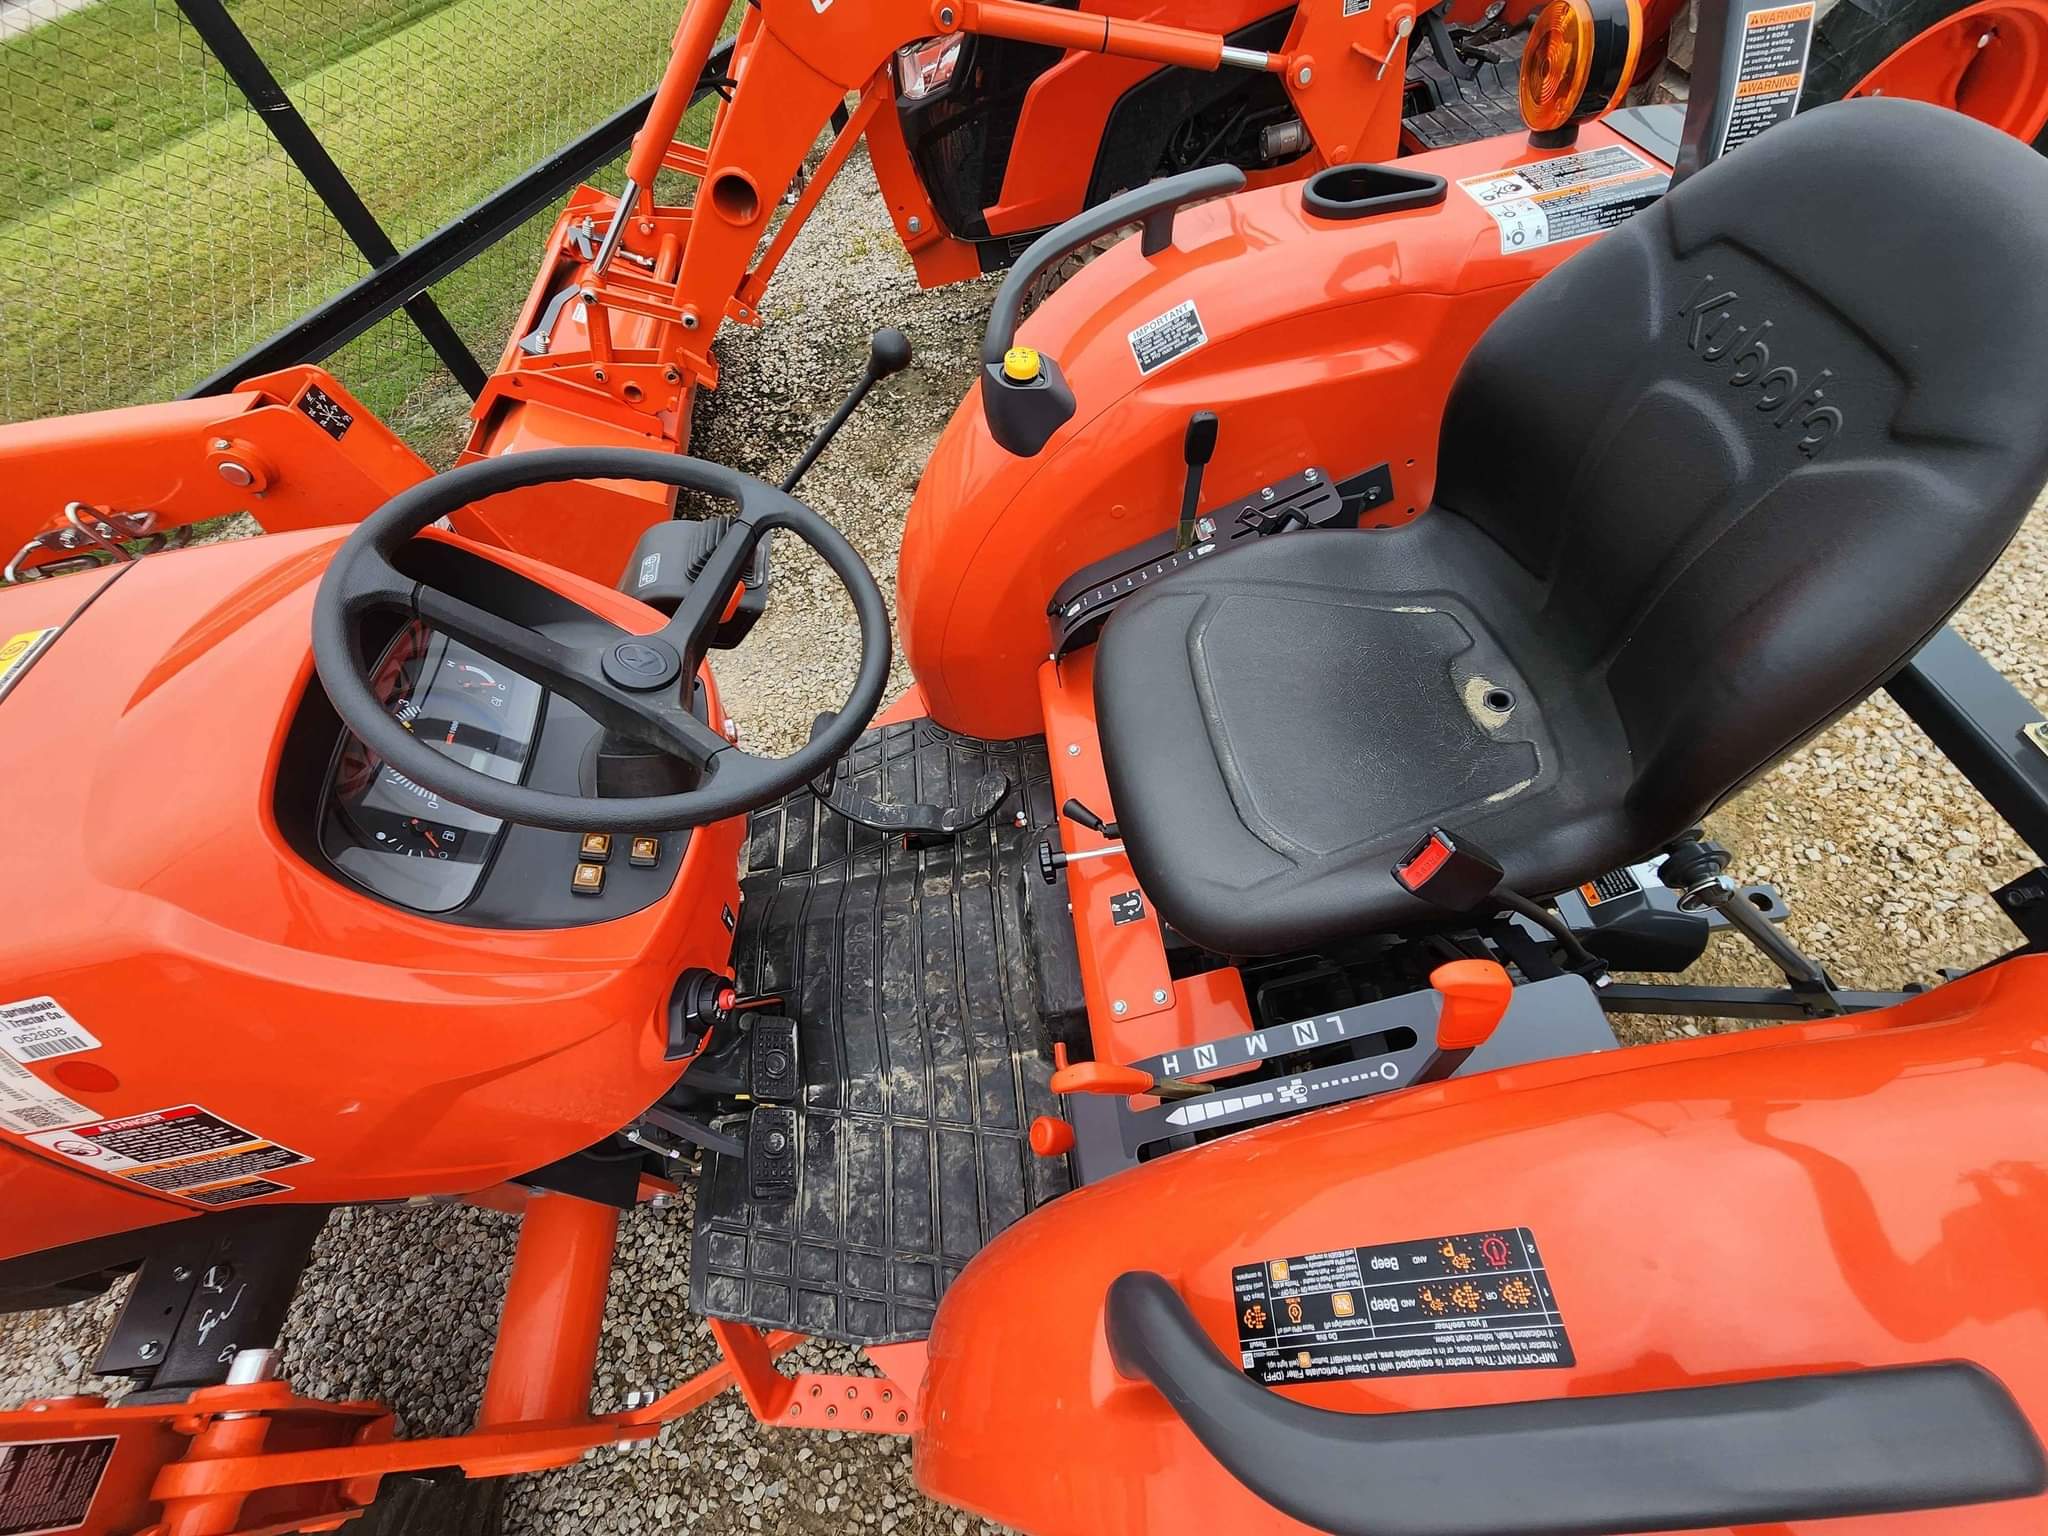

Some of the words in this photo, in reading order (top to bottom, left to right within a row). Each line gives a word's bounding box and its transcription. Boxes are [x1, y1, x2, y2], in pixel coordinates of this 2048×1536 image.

[1760, 7, 1812, 23] WARNING
[1748, 76, 1799, 92] WARNING
[1131, 304, 1188, 339] IMPORTANT
[1678, 274, 1843, 459] Kubota
[447, 660, 456, 668] H
[498, 683, 506, 691] C
[398, 698, 410, 707] 3
[427, 801, 439, 809] 0
[8, 1015, 47, 1028] Tractor
[46, 1012, 65, 1020] Co.
[1326, 1016, 1345, 1035] L
[12, 1027, 67, 1044] 062808
[1294, 1023, 1317, 1044] N
[1246, 1033, 1268, 1055] M
[1195, 1046, 1216, 1068] N
[1162, 1055, 1180, 1075] H
[109, 1114, 165, 1131] DANGER
[1526, 1243, 1535, 1253] 2
[1370, 1256, 1399, 1271] Beep
[1411, 1254, 1428, 1264] AND
[1483, 1290, 1498, 1300] OR
[1370, 1296, 1400, 1312] Beep
[1399, 1298, 1416, 1307] AND
[1466, 1318, 1481, 1327] you
[1315, 1333, 1328, 1341] this
[1328, 1332, 1337, 1340] Do
[1454, 1333, 1473, 1342] chart
[1472, 1332, 1494, 1341] follow
[1513, 1328, 1548, 1338] indicators
[1248, 1340, 1266, 1348] Result
[1454, 1343, 1482, 1354] indoors,
[1481, 1343, 1500, 1352] used
[1499, 1340, 1521, 1351] being
[1527, 1340, 1552, 1349] tractor
[1351, 1353, 1362, 1362] the
[1362, 1350, 1378, 1361] push
[1394, 1347, 1432, 1358] combustible
[1310, 1356, 1328, 1365] button
[1329, 1354, 1352, 1364] INHIBIT
[1394, 1357, 1434, 1370] equipped
[1434, 1358, 1444, 1368] is
[1444, 1356, 1473, 1367] tractor
[1304, 1366, 1343, 1376] Particulate
[1344, 1363, 1369, 1374] Diesel
[1376, 1361, 1394, 1372] with
[1285, 1369, 1303, 1378] Filter
